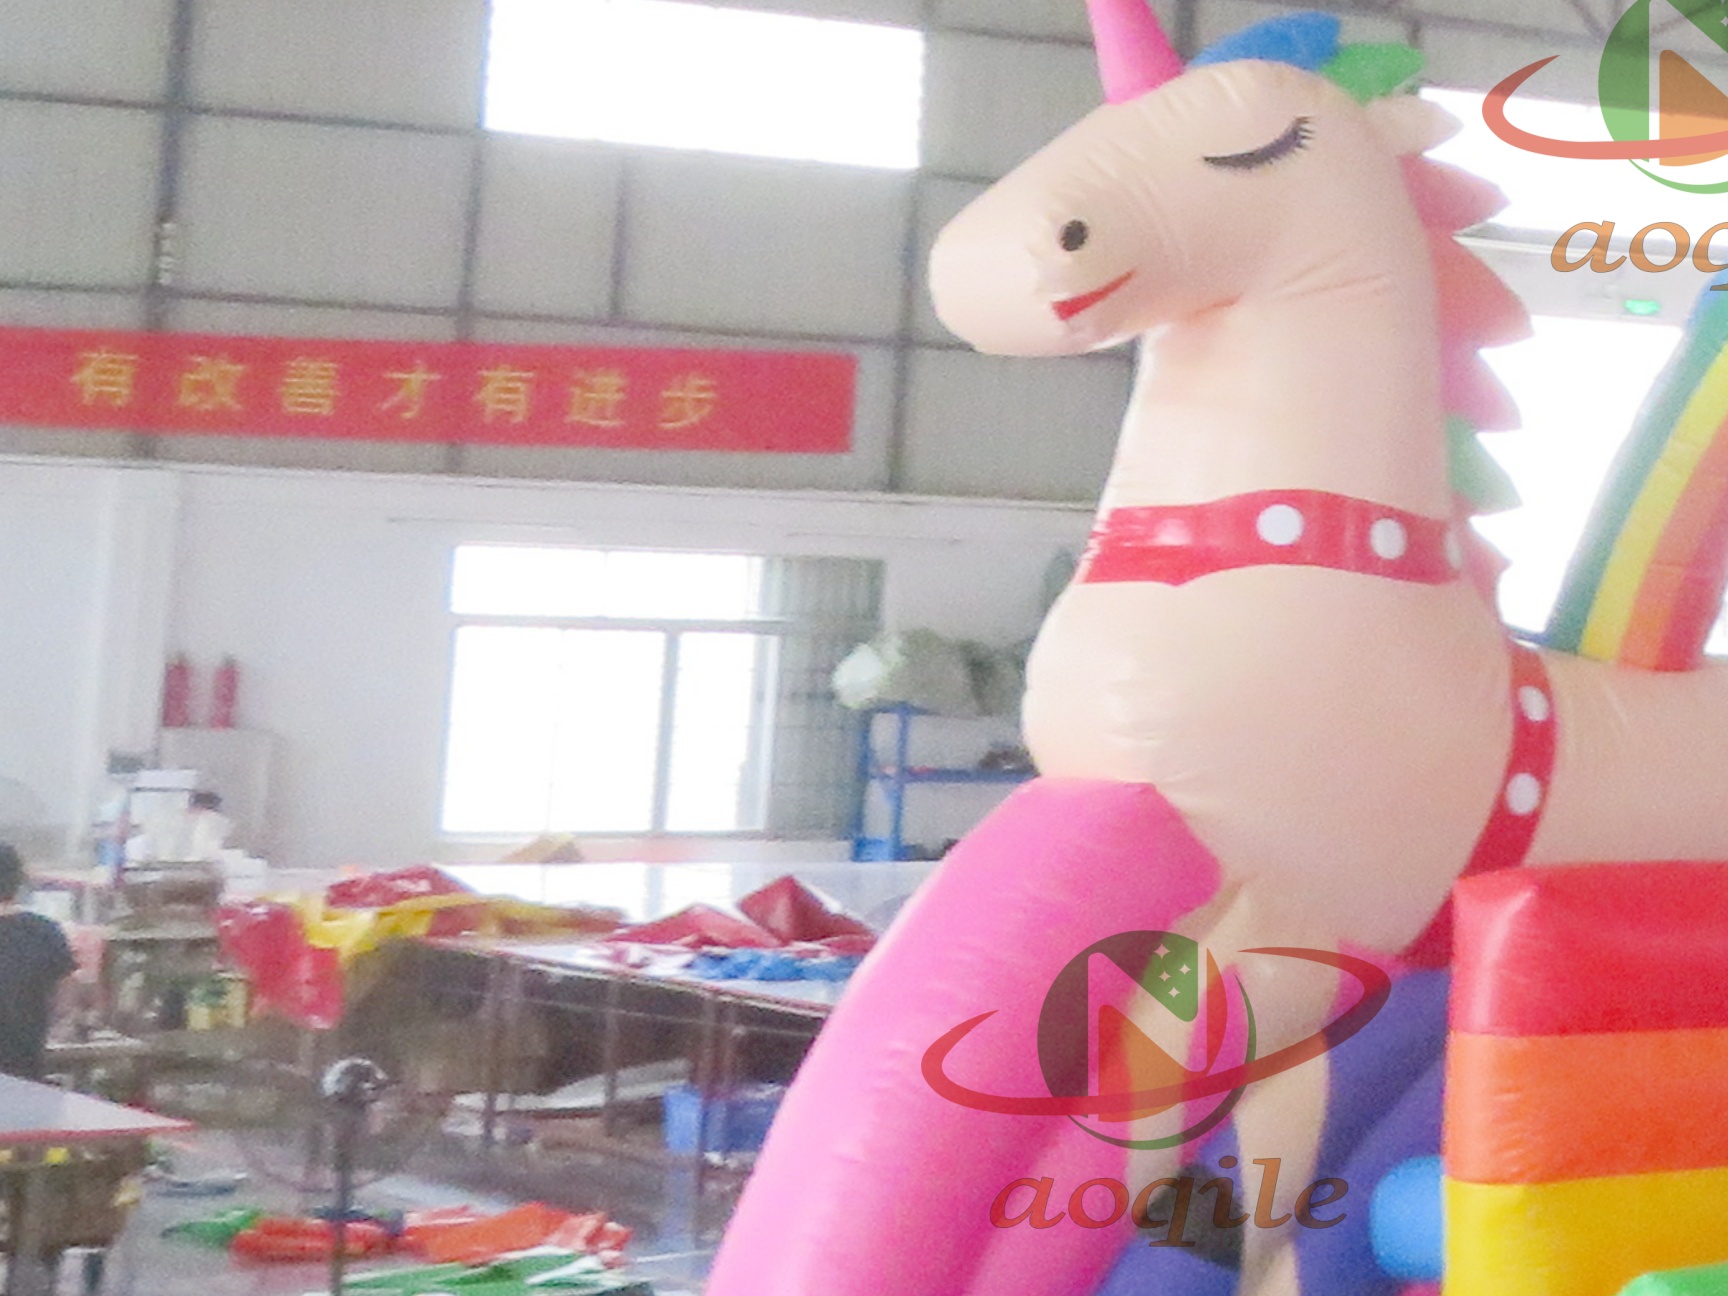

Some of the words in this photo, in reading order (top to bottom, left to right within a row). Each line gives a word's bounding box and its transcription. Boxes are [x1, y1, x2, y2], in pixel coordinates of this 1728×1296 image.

[70, 350, 719, 431] 有改善才有进步
